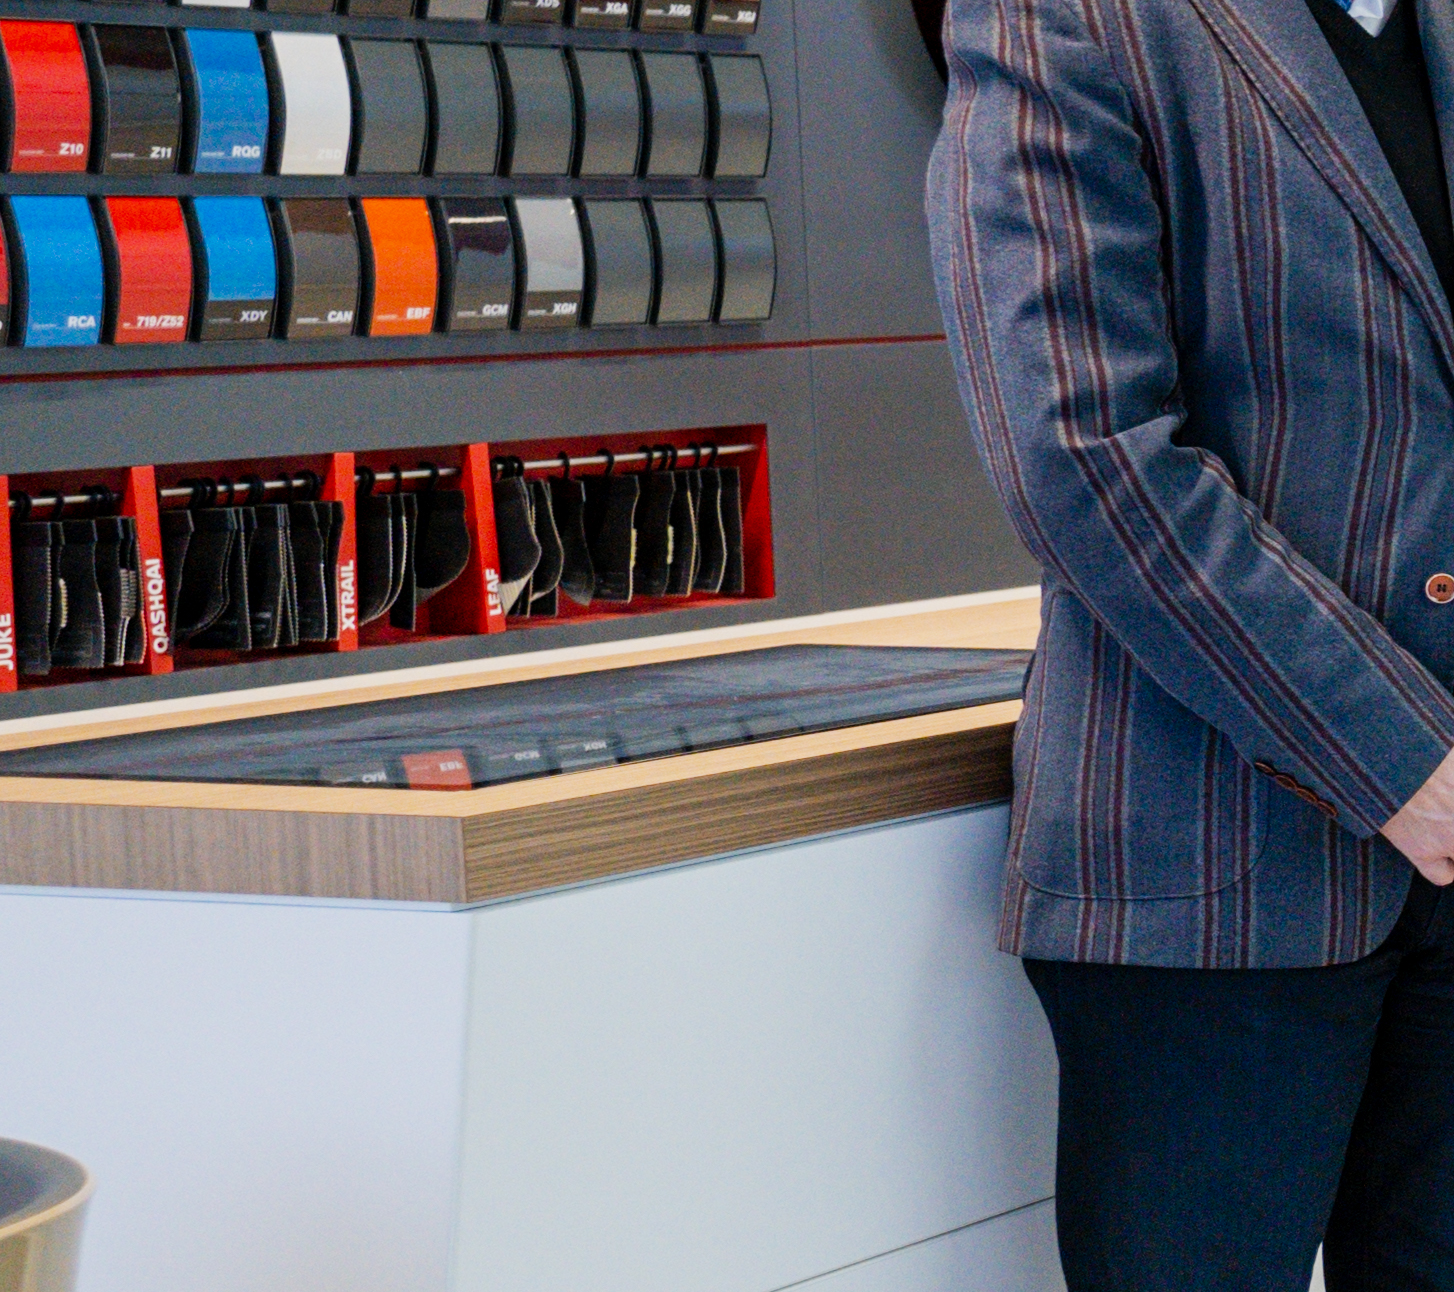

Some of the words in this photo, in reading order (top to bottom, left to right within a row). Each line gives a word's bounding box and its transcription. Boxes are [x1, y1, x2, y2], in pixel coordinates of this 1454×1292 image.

[605, 2, 628, 15] XGA
[59, 143, 84, 156] Z10
[150, 146, 172, 159] Z11
[231, 145, 261, 158] RQG
[240, 310, 268, 323] XDY
[406, 307, 431, 319] EBF
[482, 304, 508, 316] GCM
[67, 315, 96, 328] RCA
[327, 311, 353, 323] CAN
[340, 559, 356, 631] XTRAIL
[485, 567, 502, 617] LEAF
[145, 558, 169, 655] QASHQAI
[0, 613, 14, 671] JUKE
